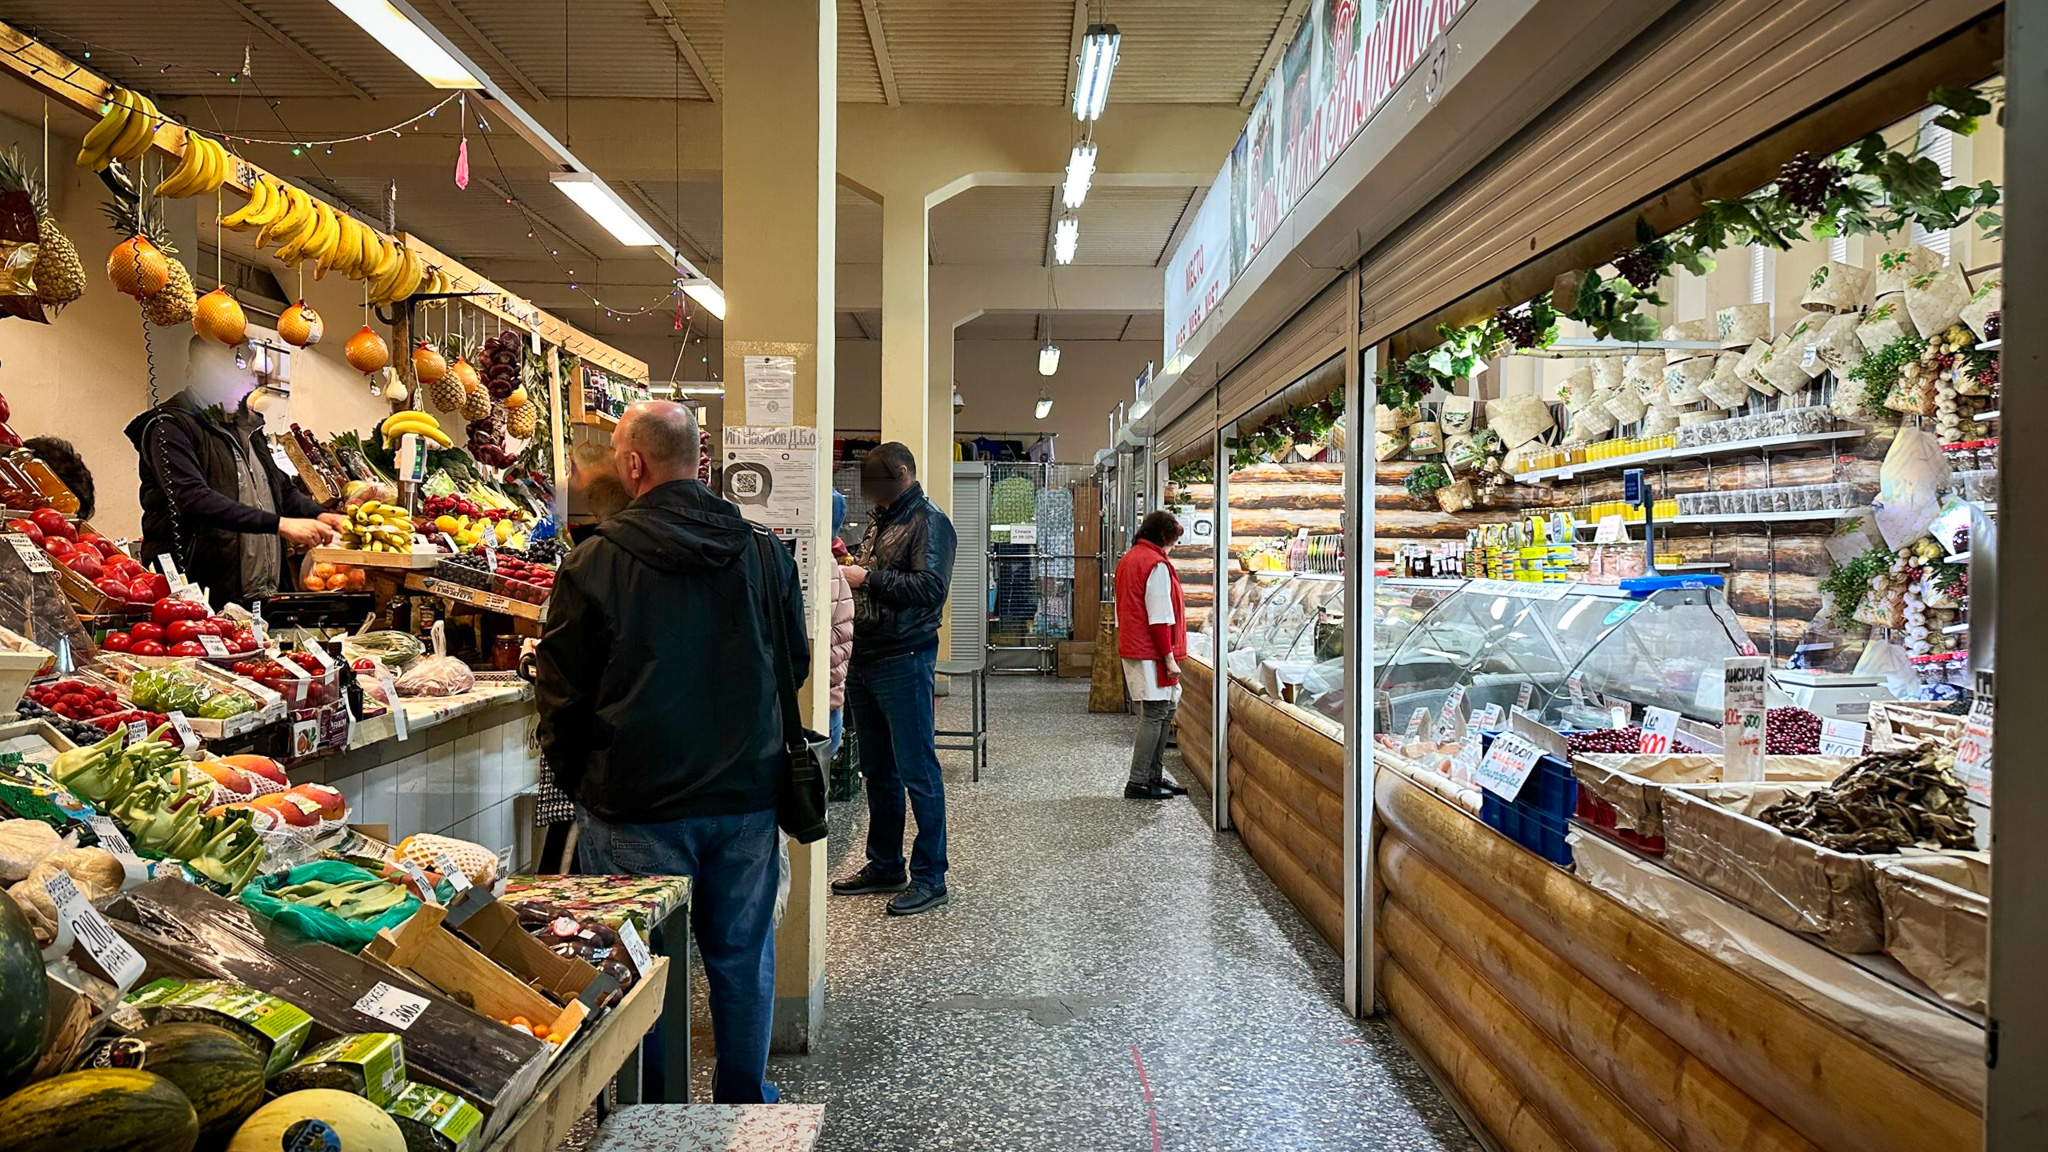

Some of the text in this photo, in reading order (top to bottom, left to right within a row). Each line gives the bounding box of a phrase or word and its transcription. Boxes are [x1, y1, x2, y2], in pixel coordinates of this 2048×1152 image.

[1430, 48, 1446, 93] 57
[1185, 244, 1204, 295] МЕСТО
[725, 428, 740, 444] ИП
[1725, 666, 1764, 683] ЛИСИЧКИ
[1744, 714, 1760, 729] 500
[101, 943, 132, 977] ИРАН
